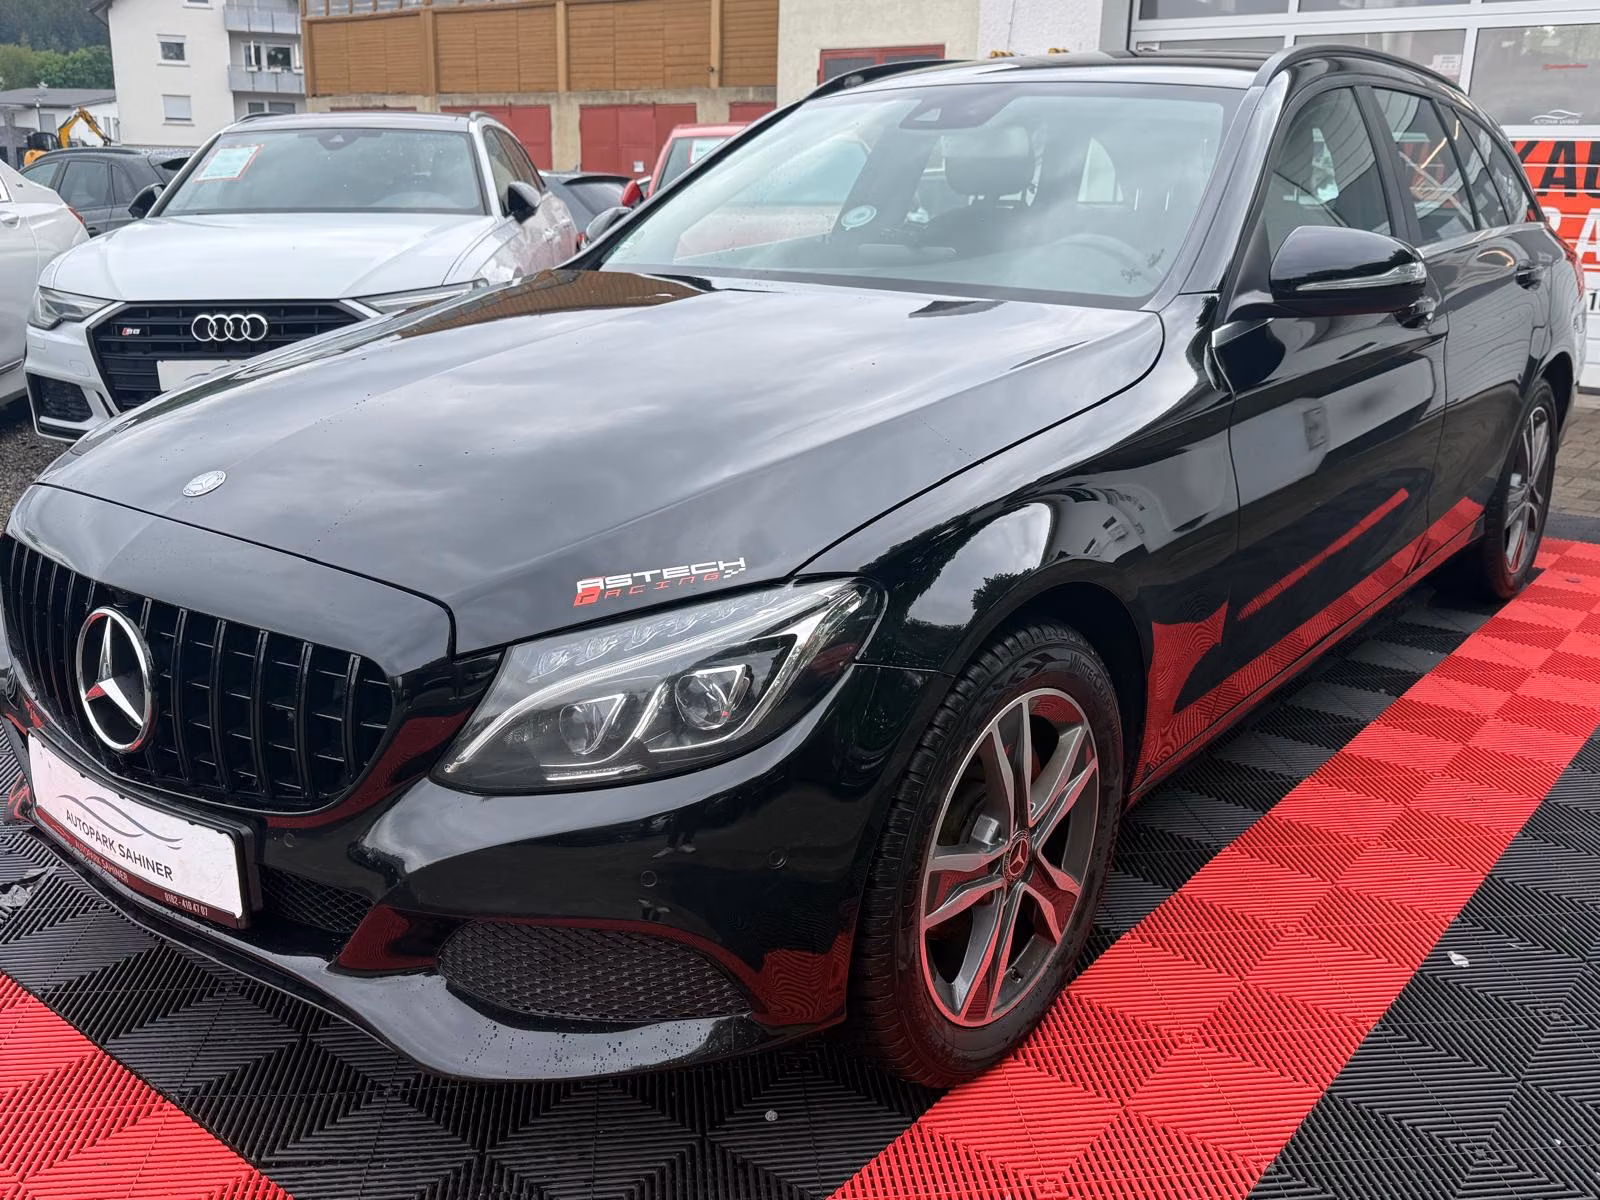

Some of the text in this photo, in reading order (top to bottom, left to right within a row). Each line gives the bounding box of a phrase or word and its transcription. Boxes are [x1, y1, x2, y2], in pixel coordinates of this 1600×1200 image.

[576, 557, 746, 593] ASTECH
[66, 809, 173, 881] AUTOPARK SAHINER
